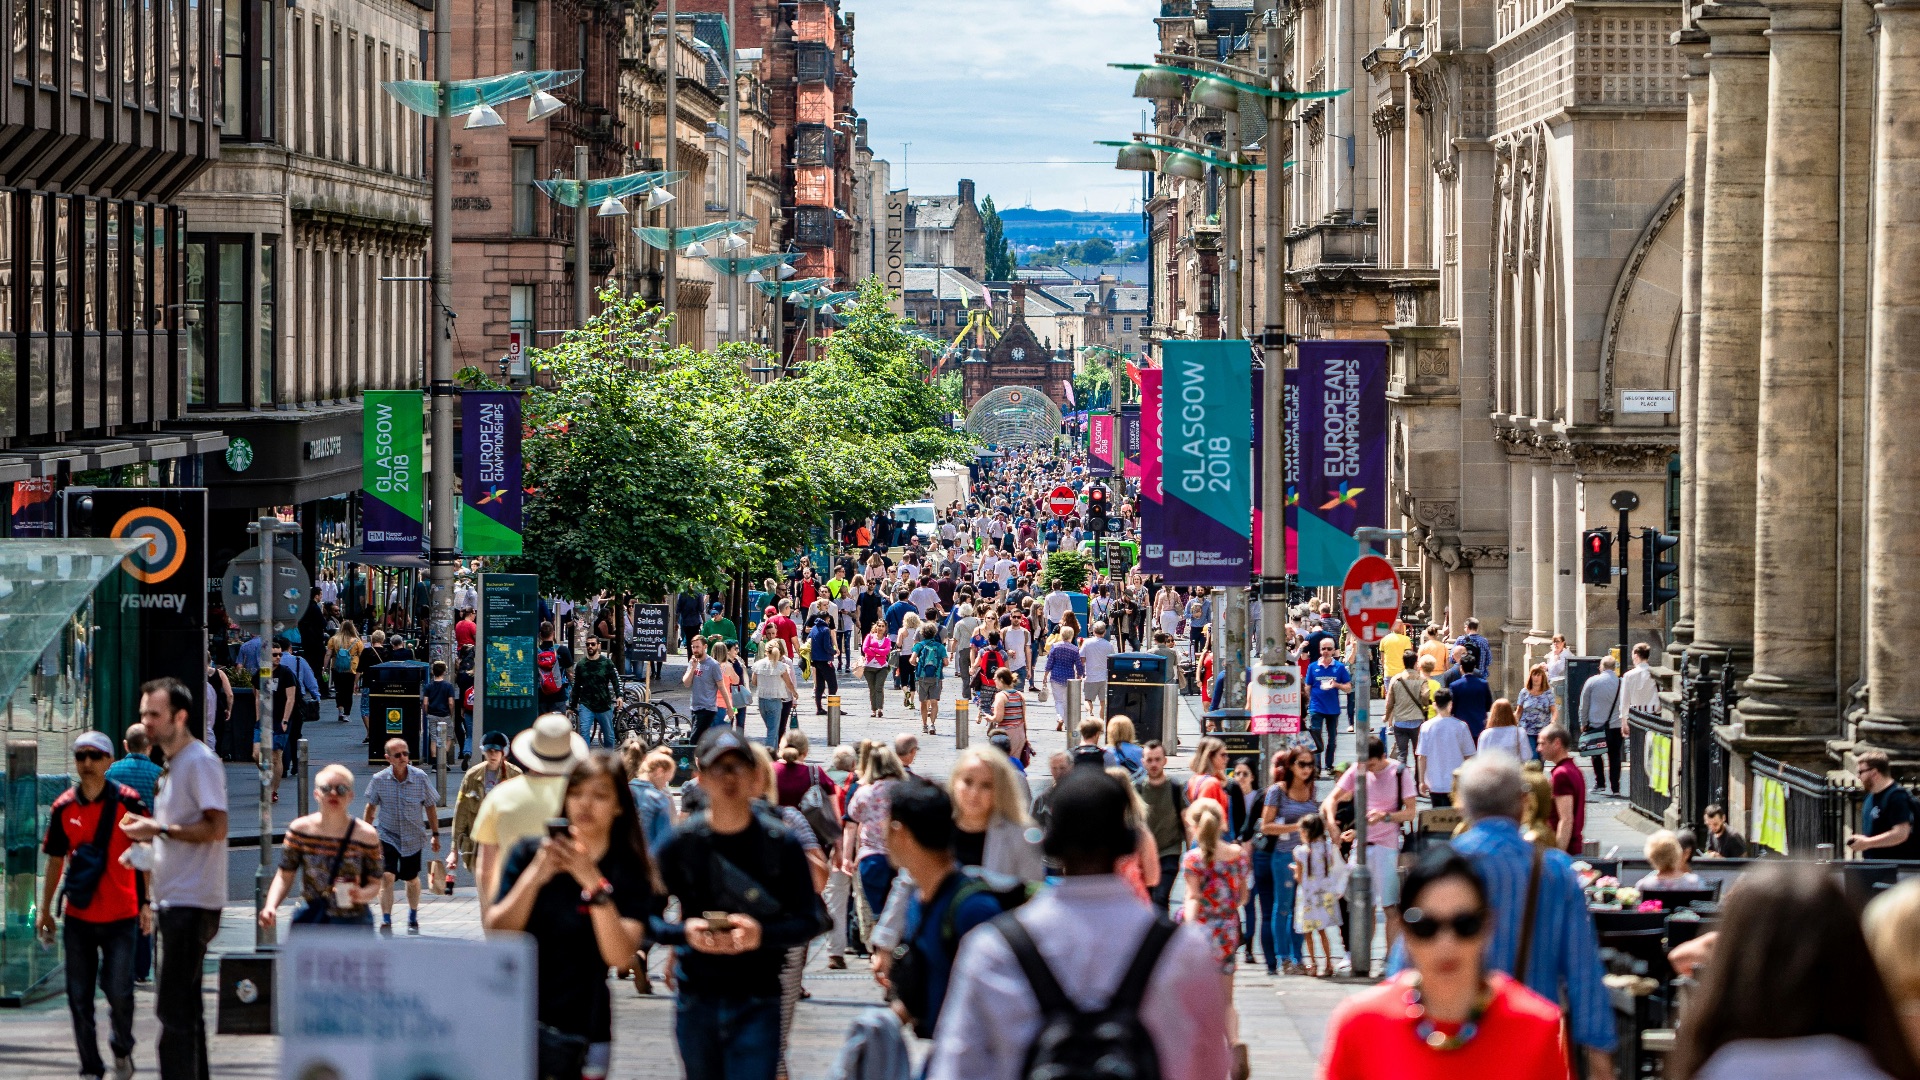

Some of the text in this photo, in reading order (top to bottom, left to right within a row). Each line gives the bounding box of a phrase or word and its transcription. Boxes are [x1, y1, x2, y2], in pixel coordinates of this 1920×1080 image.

[451, 197, 492, 211] MBERS
[888, 202, 902, 222] ST
[1182, 360, 1206, 493] GLASGOW
[1324, 359, 1345, 477] EUROPEAN
[1345, 359, 1360, 477] CHAMPIONSHIPS
[376, 404, 392, 493] GLASGOW
[480, 403, 494, 482] EUROPEAN
[494, 403, 505, 482] CHAMPIONSHIPS
[394, 454, 409, 492] 2018
[1208, 436, 1231, 492] 2018
[1171, 551, 1222, 564] HM Harper
[1228, 558, 1244, 566] LLP
[637, 617, 664, 625] Sales &
[640, 607, 662, 616] Apple
[636, 627, 664, 636] Repairs
